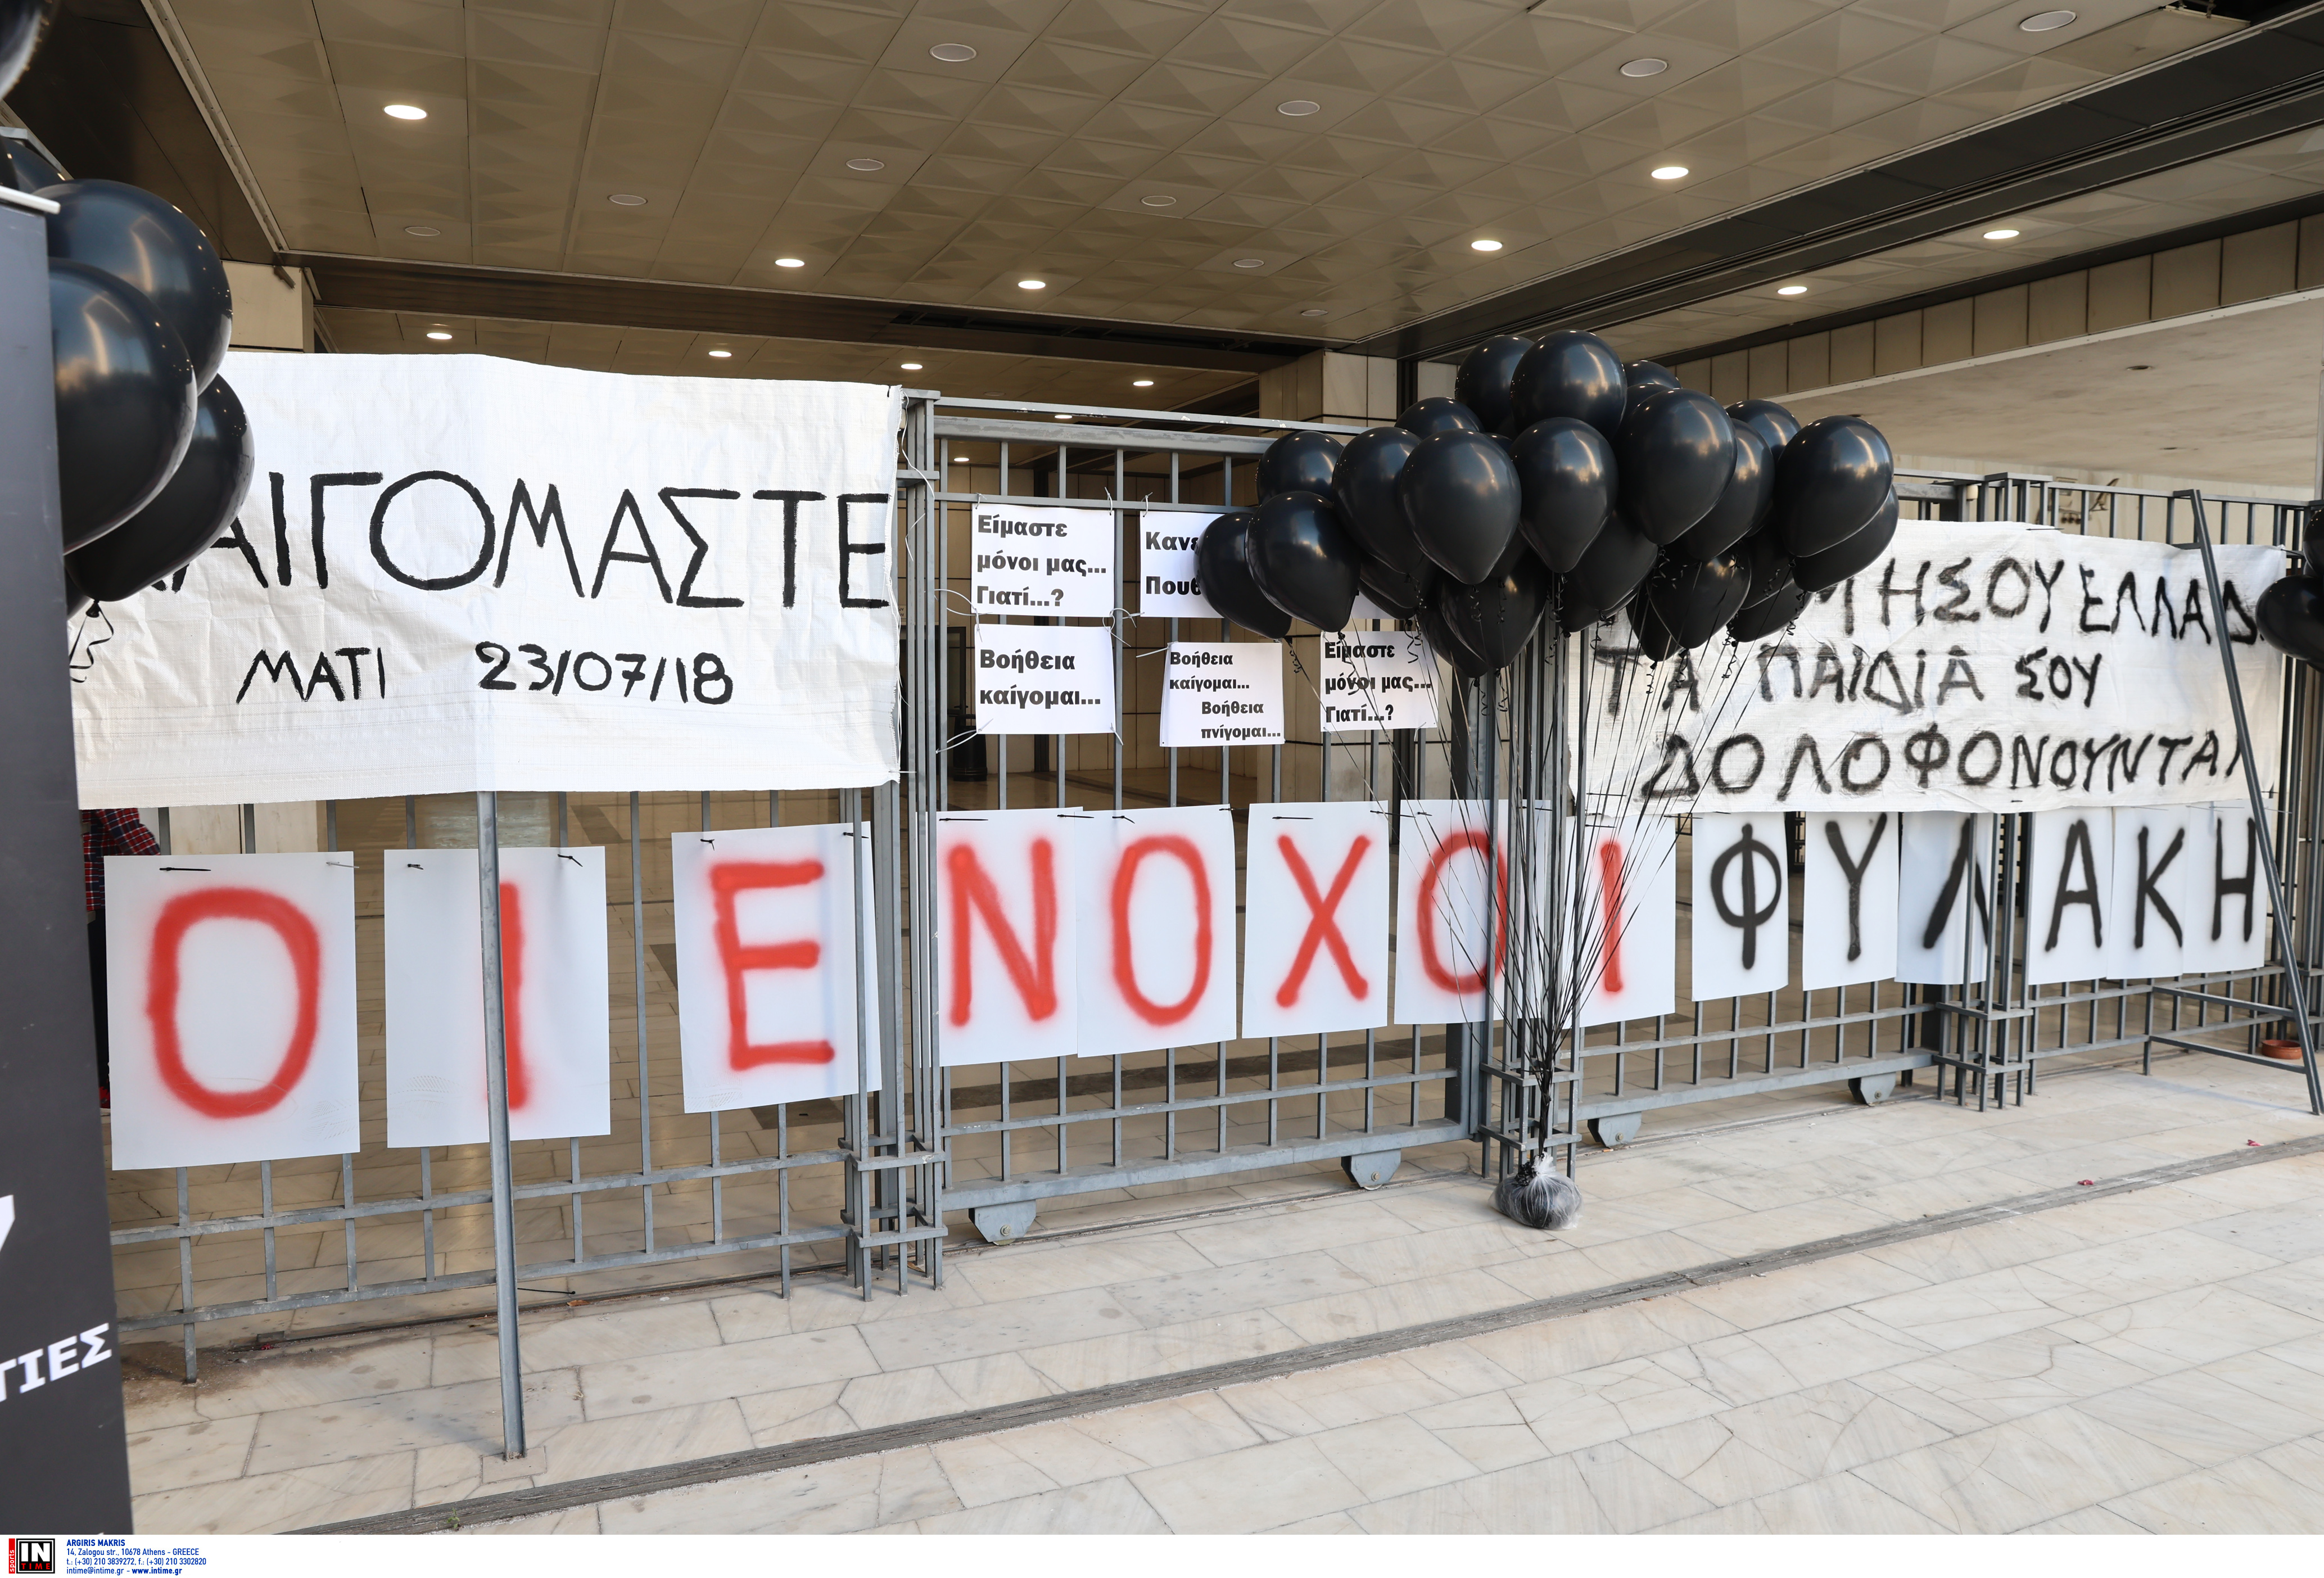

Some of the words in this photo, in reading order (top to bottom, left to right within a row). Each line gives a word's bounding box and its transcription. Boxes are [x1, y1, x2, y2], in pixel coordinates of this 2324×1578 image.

[978, 514, 1068, 537] Είμαστε
[150, 471, 890, 609] ΑΙΓΟΜΑΣΤΕ
[1146, 532, 1199, 551] Κανε
[978, 550, 1038, 572] μόνοι
[1047, 558, 1106, 577] μας...
[977, 586, 1064, 606] Γιατί...?
[1146, 576, 1201, 596] Πουθ
[2079, 564, 2264, 645] ΕΛΛΑΔ
[980, 649, 1075, 673] Βοήθεια
[1170, 652, 1233, 667] Βοήθεια
[1325, 640, 1395, 662] Είμαστε
[236, 648, 385, 703] ΜΑΤΙ
[475, 641, 733, 704] 23/07/18
[1169, 675, 1250, 692] καίγομαι...
[1325, 672, 1376, 694] μόνοι
[1381, 676, 1431, 693] μας...
[1594, 646, 1700, 717] ΤΑ
[1756, 643, 1985, 714] ΠΑΙΔΙΑ
[2015, 647, 2102, 707] ΣΟΥ
[980, 685, 1101, 709] καίγομαι...
[1202, 700, 1264, 717] Βοήθεια
[1326, 703, 1394, 723] Γιατί...?
[1201, 724, 1281, 740] πνίγομαι...
[710, 831, 1624, 1070] ΕΝΟΧΟΙ
[1710, 813, 2255, 970] ΦΥΛΑΚΗ
